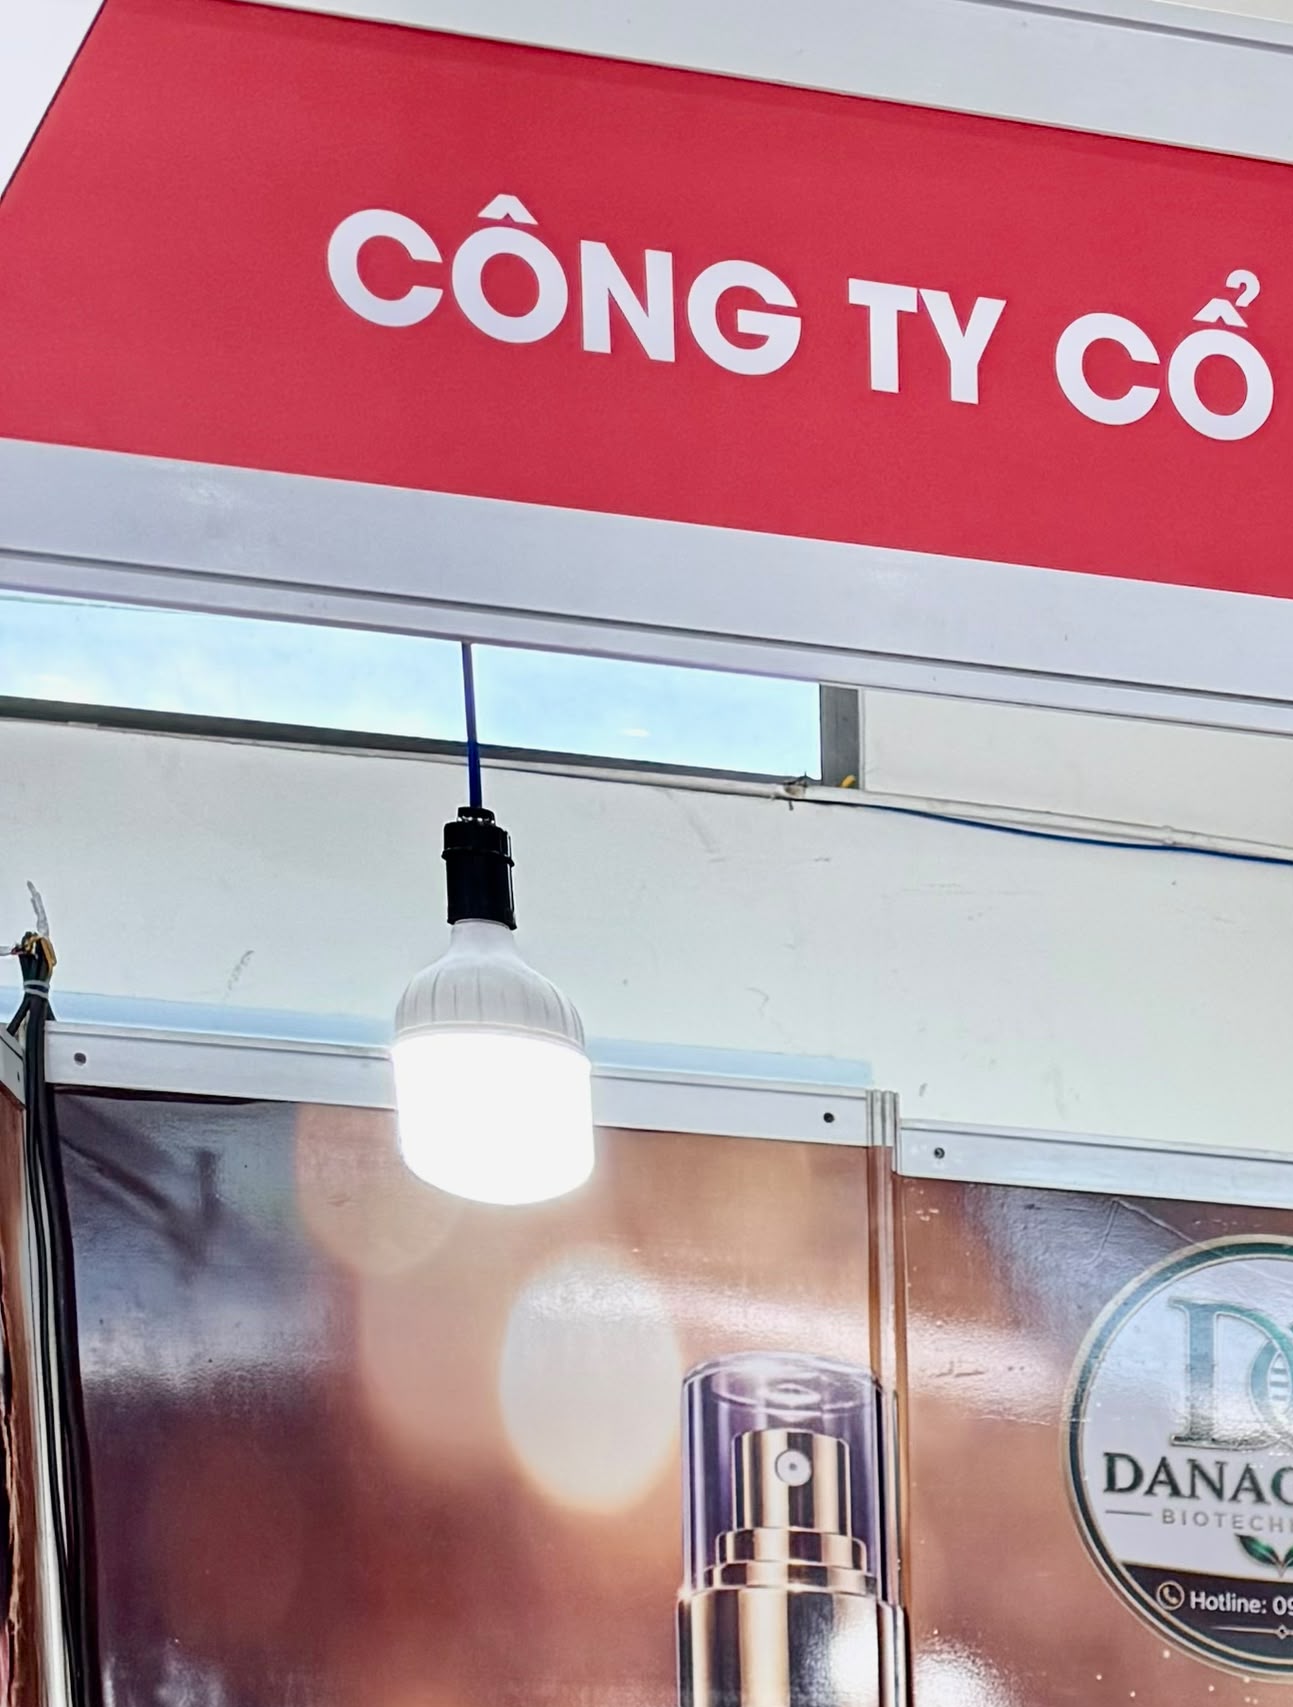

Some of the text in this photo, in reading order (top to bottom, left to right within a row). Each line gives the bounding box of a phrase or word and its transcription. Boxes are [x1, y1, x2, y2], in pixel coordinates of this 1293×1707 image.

[326, 193, 802, 376] CÔNG
[847, 277, 1007, 405] TY
[1054, 269, 1274, 441] CỔ
[1190, 1589, 1268, 1615] Hotline:
